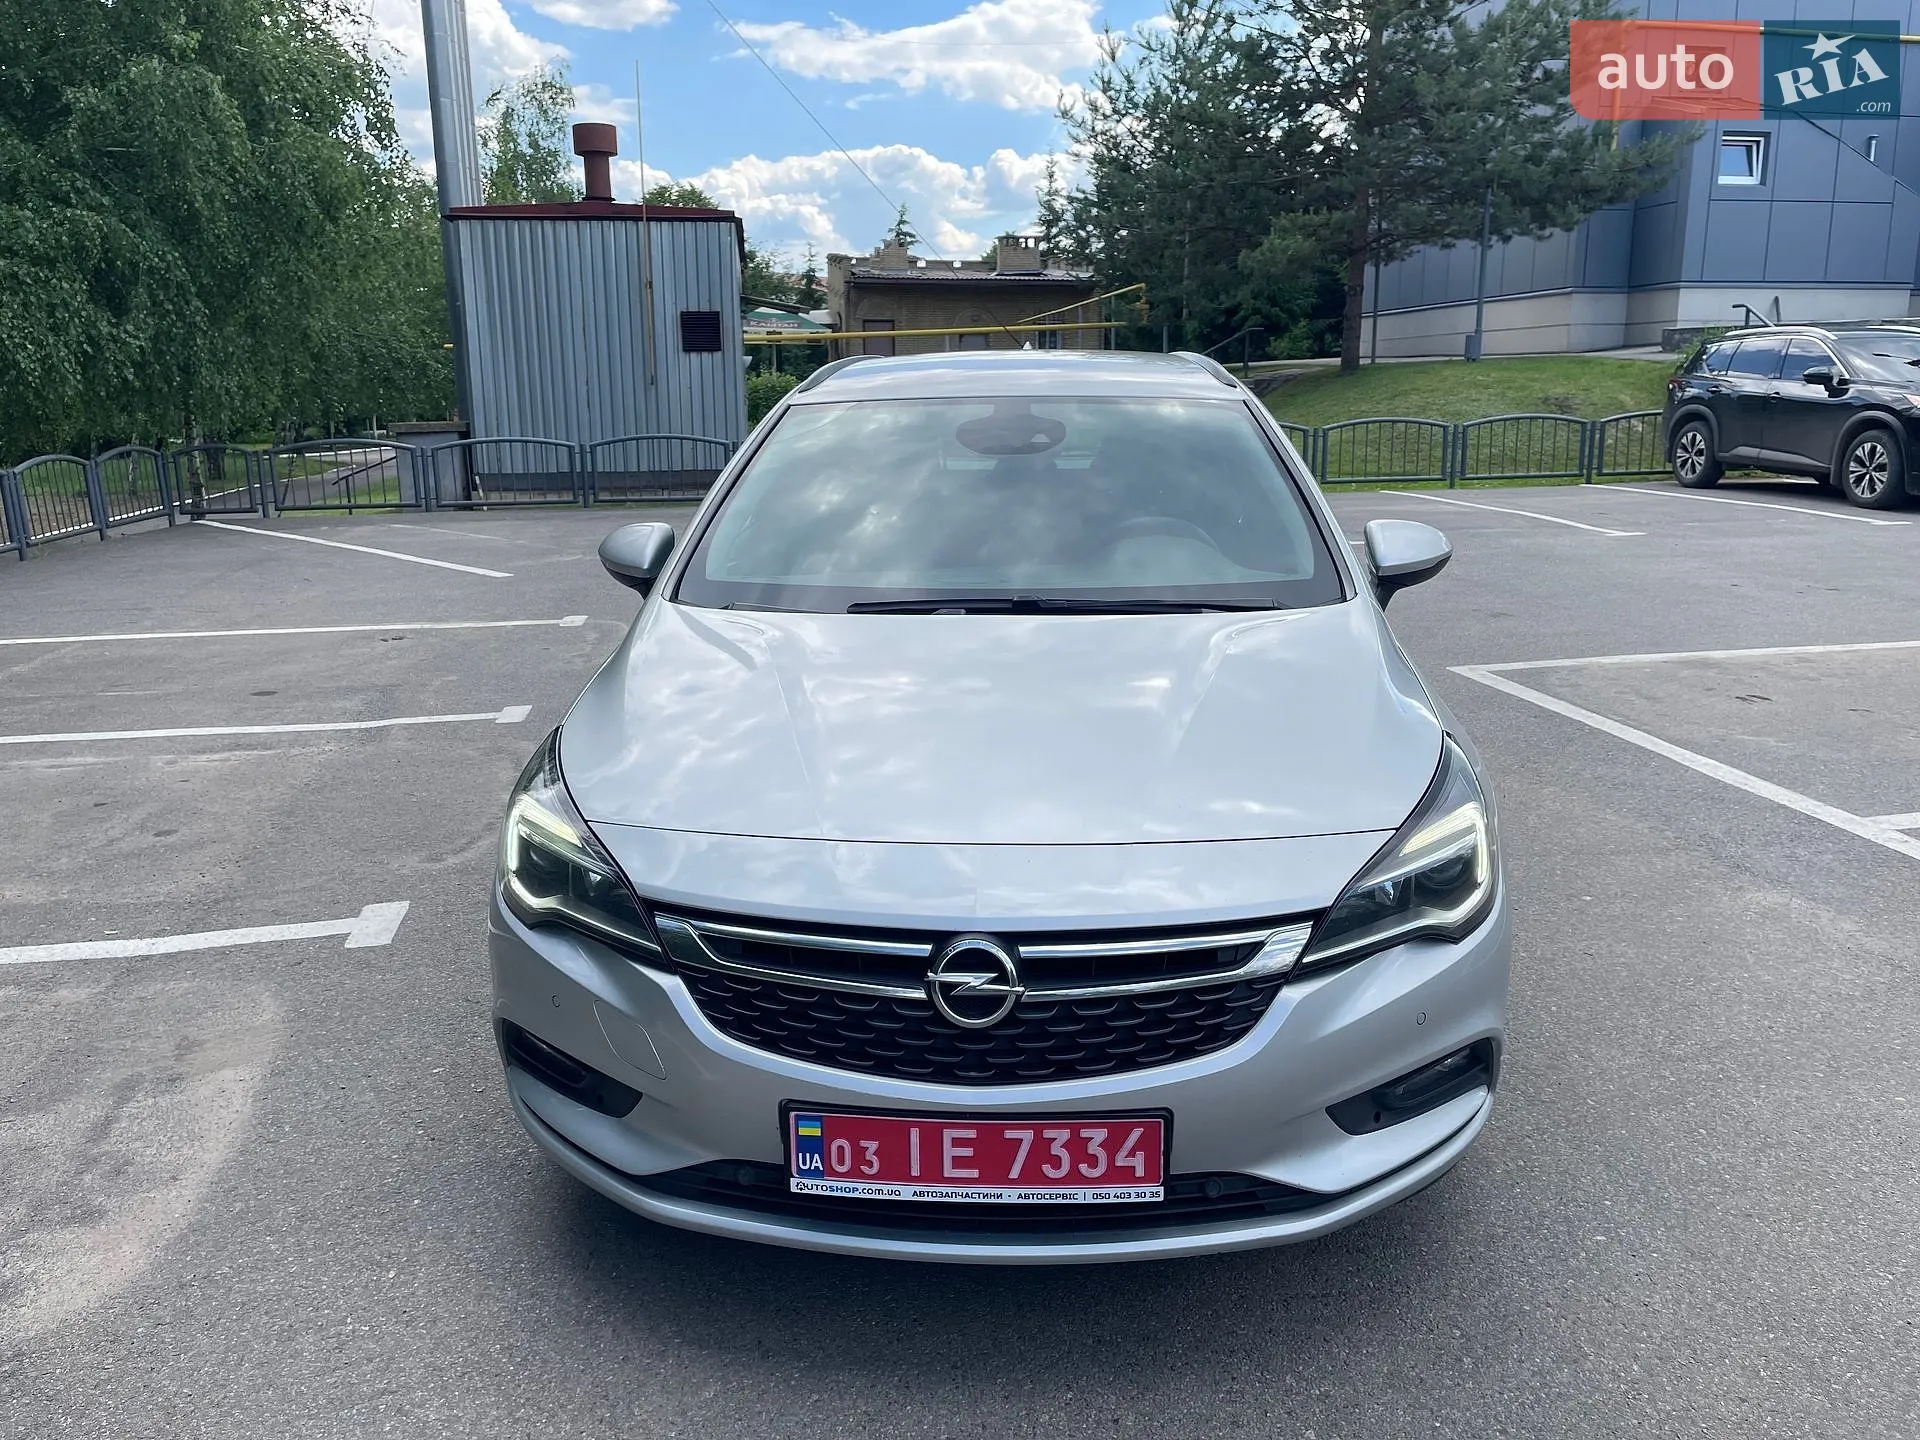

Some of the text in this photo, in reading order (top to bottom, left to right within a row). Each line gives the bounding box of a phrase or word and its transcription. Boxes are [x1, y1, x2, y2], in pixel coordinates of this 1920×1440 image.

[798, 1151, 824, 1171] UA
[830, 1138, 879, 1175] 03
[1004, 1128, 1144, 1179] 7334
[911, 1190, 1003, 1200] АВТОЗАПЧАСТИНИ
